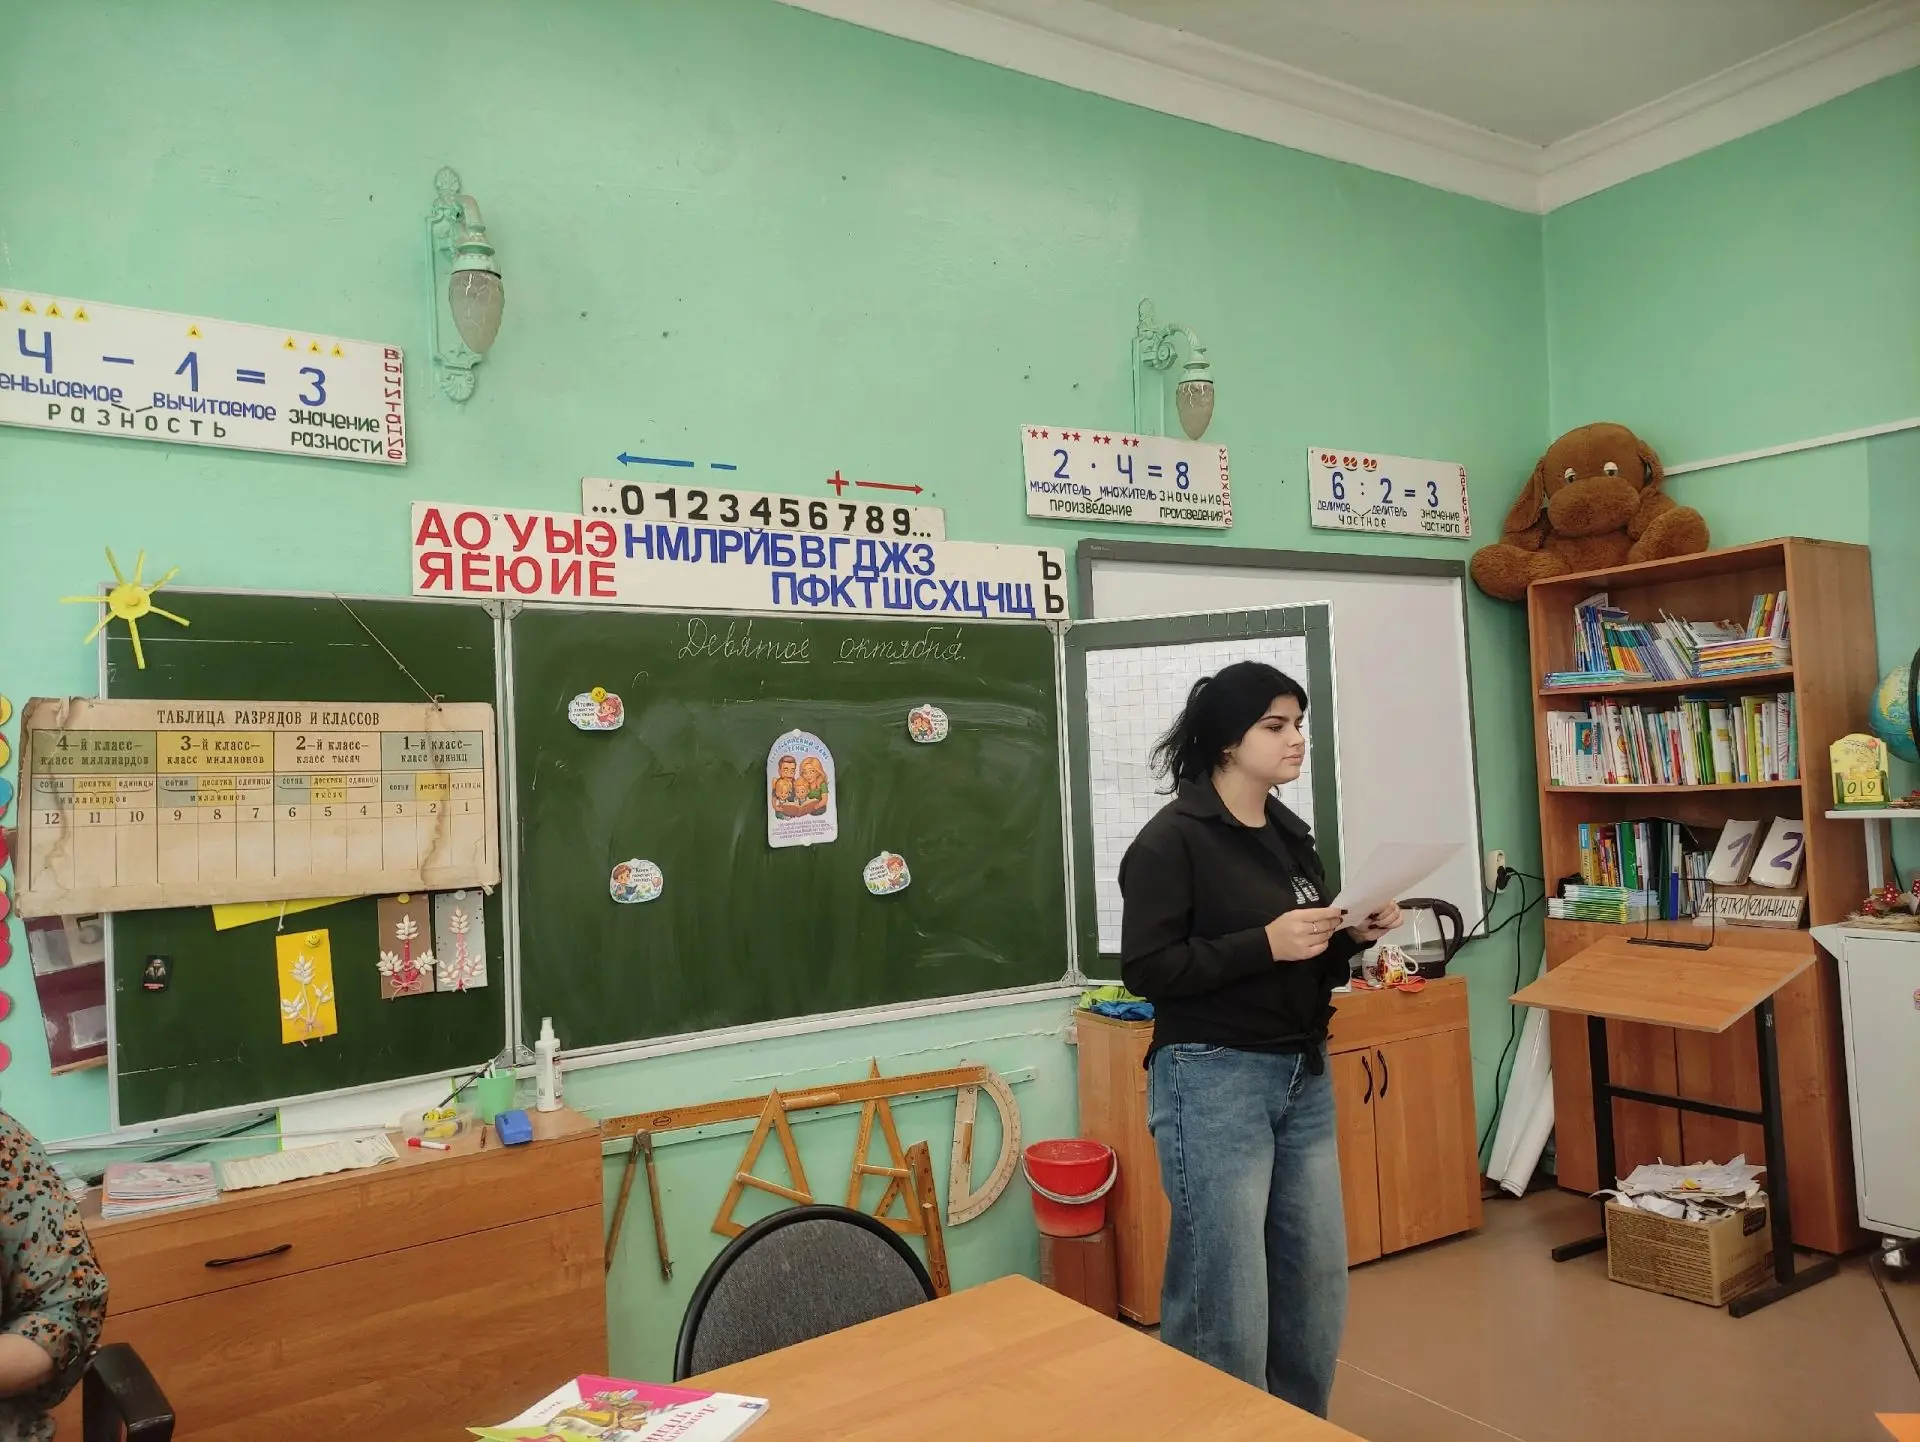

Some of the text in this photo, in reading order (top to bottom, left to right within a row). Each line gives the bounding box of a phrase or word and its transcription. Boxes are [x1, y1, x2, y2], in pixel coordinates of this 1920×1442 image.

[18, 328, 53, 374] 4
[174, 351, 199, 392] 1
[299, 366, 326, 407] 3
[153, 391, 277, 421] вычитаемое
[48, 402, 227, 438] разность
[288, 408, 380, 433] значение
[291, 431, 383, 456] разности
[1053, 449, 1070, 479] 2
[1116, 454, 1133, 484] 4
[1175, 461, 1190, 490] 8
[1029, 480, 1222, 505] множитель множитель значение
[1332, 471, 1345, 500] 6
[1380, 478, 1393, 504] 2
[1426, 480, 1439, 508] 3
[1317, 499, 1460, 522] делимое делитель значение
[1338, 514, 1460, 534] частное частного
[156, 709, 380, 728] ТАБЛИЦА РАЗРЯДОВ И КЛАССОВ
[40, 755, 149, 767] класс миллиардов
[167, 755, 265, 765] класс миллионов
[296, 754, 361, 764] класс тысяч
[401, 753, 467, 763] класс единиц
[118, 780, 154, 789] единицы
[45, 801, 469, 825] 12 11 10 9 8 7 6 5 4 3 2 1
[1728, 832, 1804, 871] 1 2
